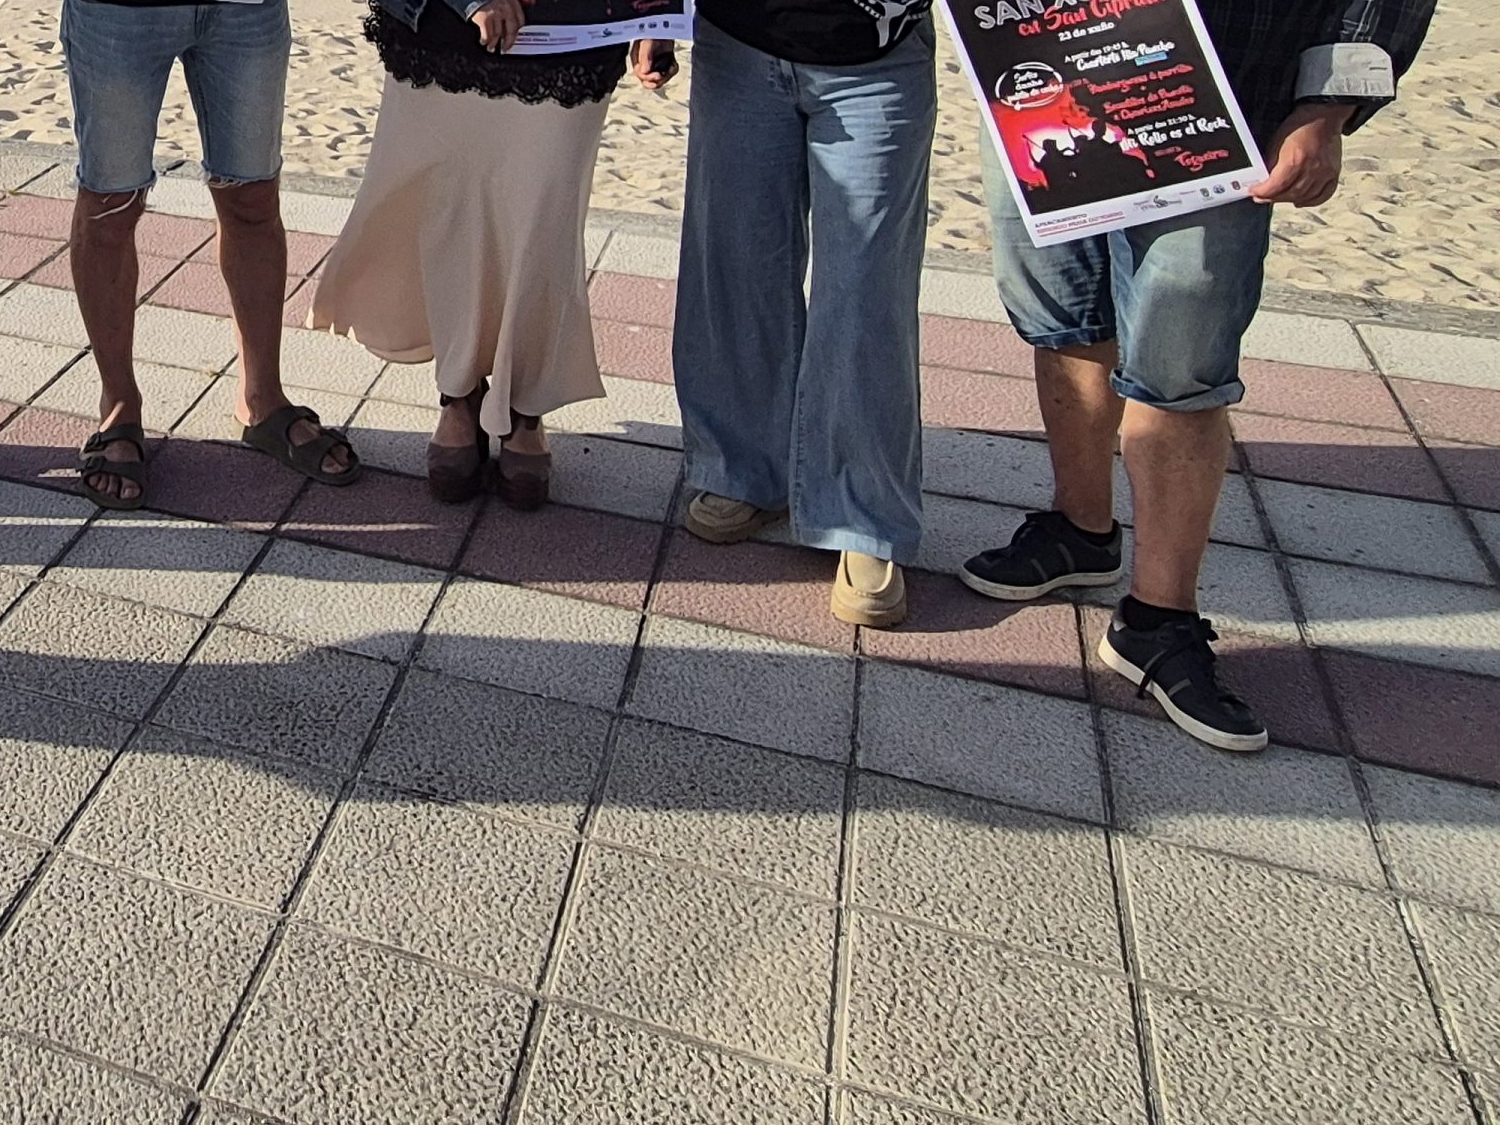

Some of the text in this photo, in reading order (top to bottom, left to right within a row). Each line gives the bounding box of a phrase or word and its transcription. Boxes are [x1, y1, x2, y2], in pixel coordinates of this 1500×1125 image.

[1018, 21, 1041, 36] en
[1044, 6, 1088, 30] San
[1058, 31, 1072, 41] 23
[1196, 117, 1230, 133] Rock
